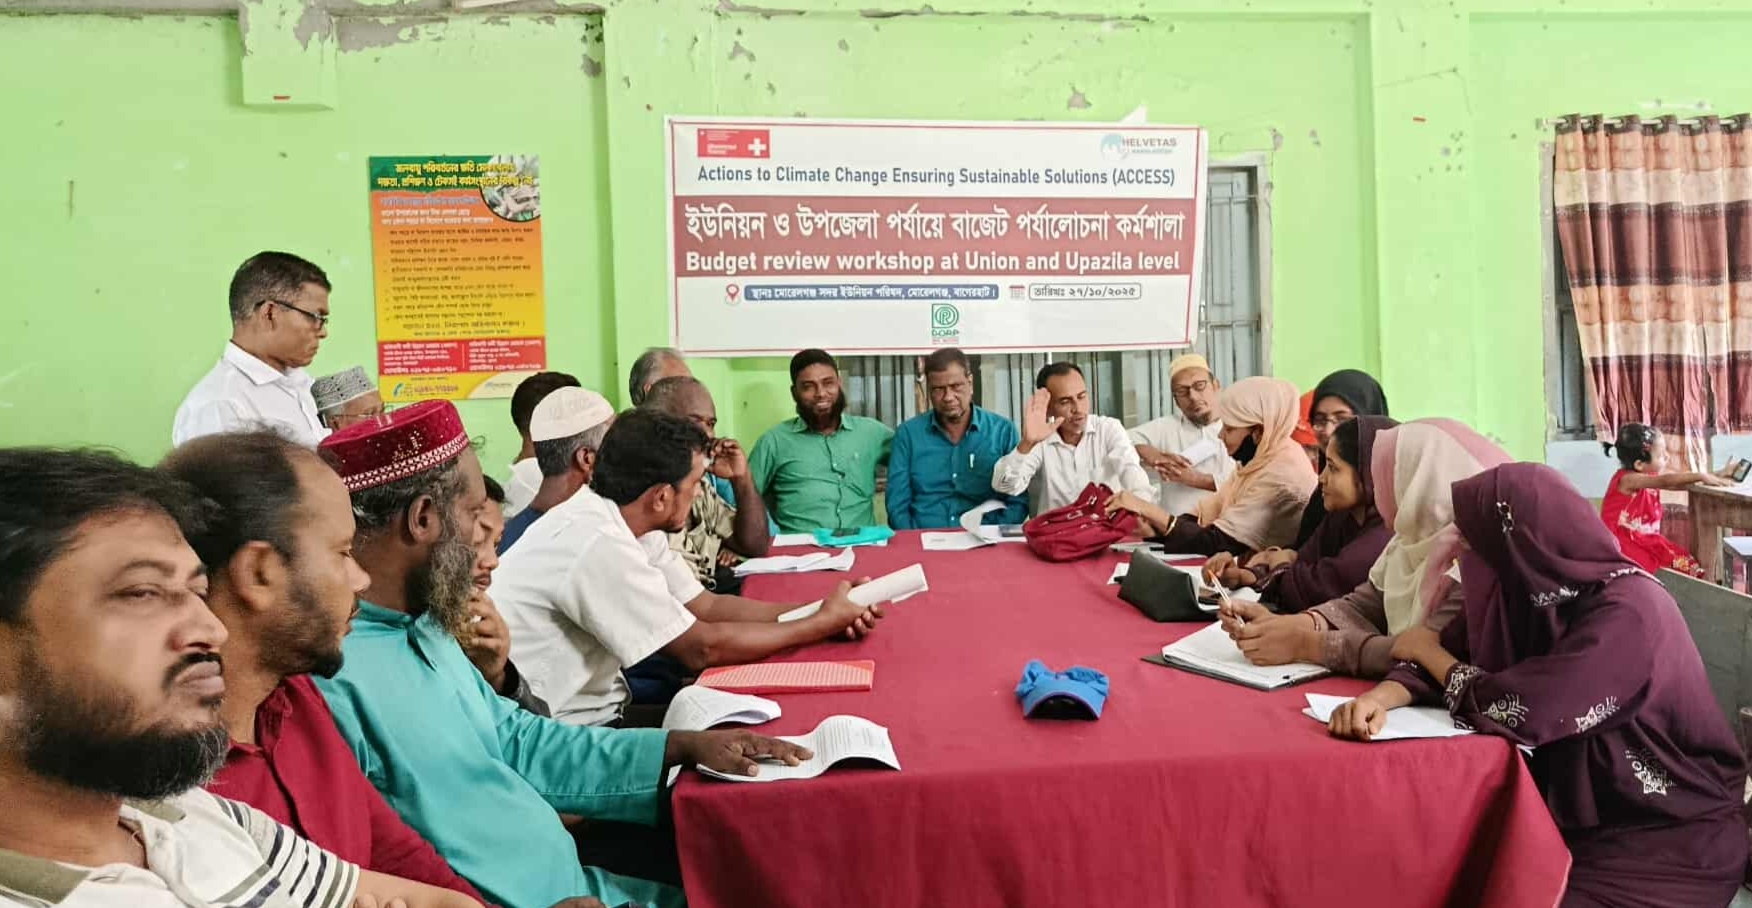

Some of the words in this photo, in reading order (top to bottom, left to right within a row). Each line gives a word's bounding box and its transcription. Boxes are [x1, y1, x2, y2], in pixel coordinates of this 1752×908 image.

[1122, 137, 1177, 147] HELVETAS
[697, 165, 752, 182] Actions
[757, 167, 770, 182] to
[776, 166, 830, 183] Climate
[835, 167, 888, 187] Change
[893, 167, 955, 187] Ensuring
[960, 168, 1039, 184] Sustainable
[1045, 168, 1107, 185] Solutions
[1113, 168, 1175, 187] (ACCESS)
[685, 203, 767, 242] ইউনিয়ন
[773, 213, 790, 237] ও
[796, 203, 880, 240] উপজেলা
[886, 203, 945, 240] পর্যায়ে
[949, 204, 1010, 240] বাজেট
[1016, 203, 1111, 241] পর্যালোচনা
[1114, 204, 1185, 241] কর্মশালা
[686, 251, 757, 275] Budget
[763, 251, 830, 270] review
[837, 251, 935, 274] workshop
[941, 253, 959, 270] at
[965, 251, 1020, 270] Union
[1026, 251, 1060, 270] and
[1066, 251, 1133, 275] Upazila
[1139, 251, 1180, 270] level
[1069, 286, 1136, 298] ২৭/১০/২০২৫
[931, 329, 960, 337] DORP
